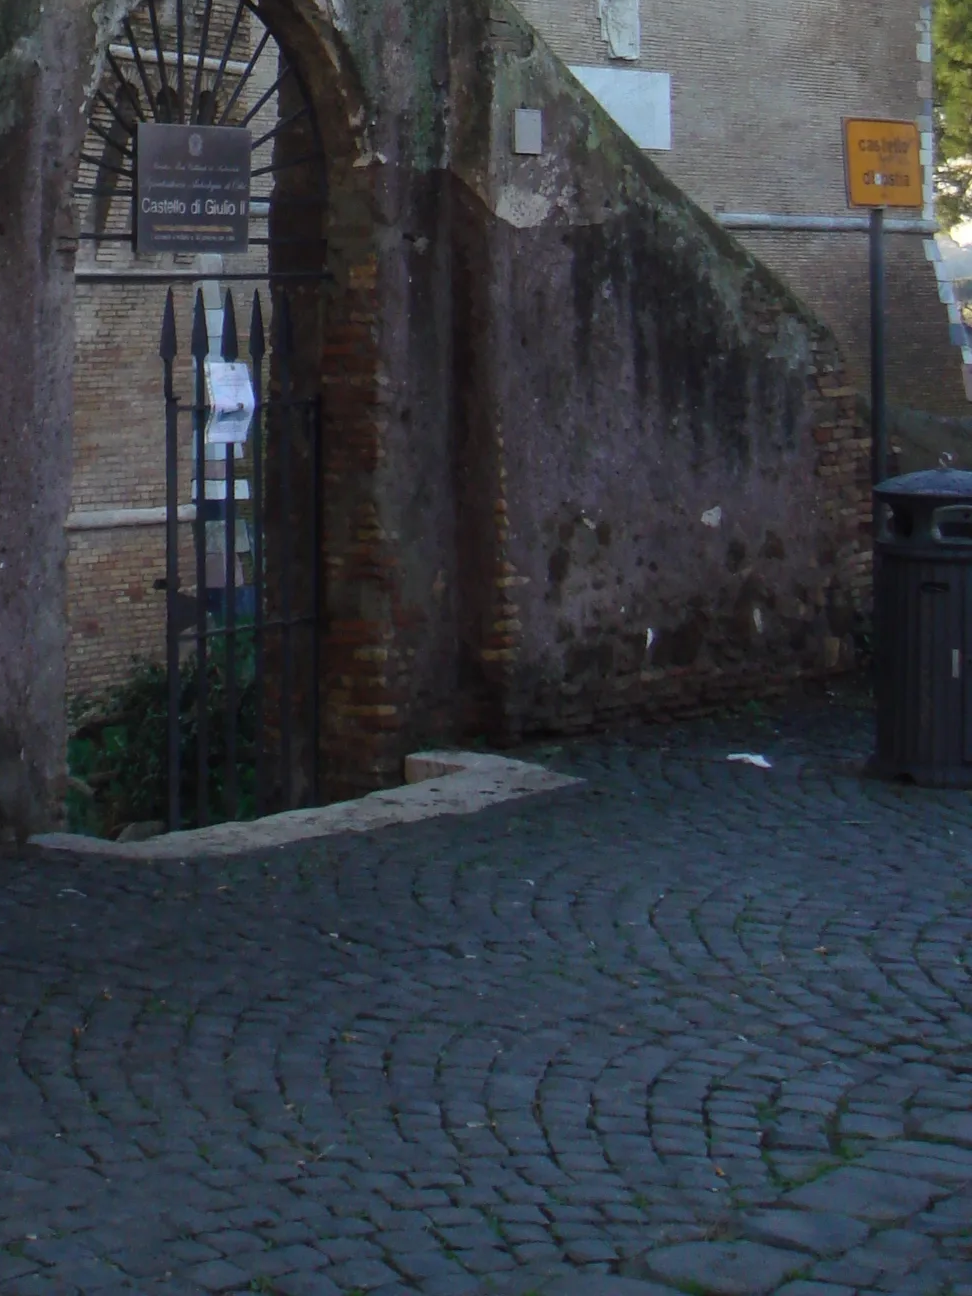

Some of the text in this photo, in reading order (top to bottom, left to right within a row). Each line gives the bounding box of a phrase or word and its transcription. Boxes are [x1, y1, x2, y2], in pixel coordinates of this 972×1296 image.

[141, 197, 246, 216] Castello di Giulio II
